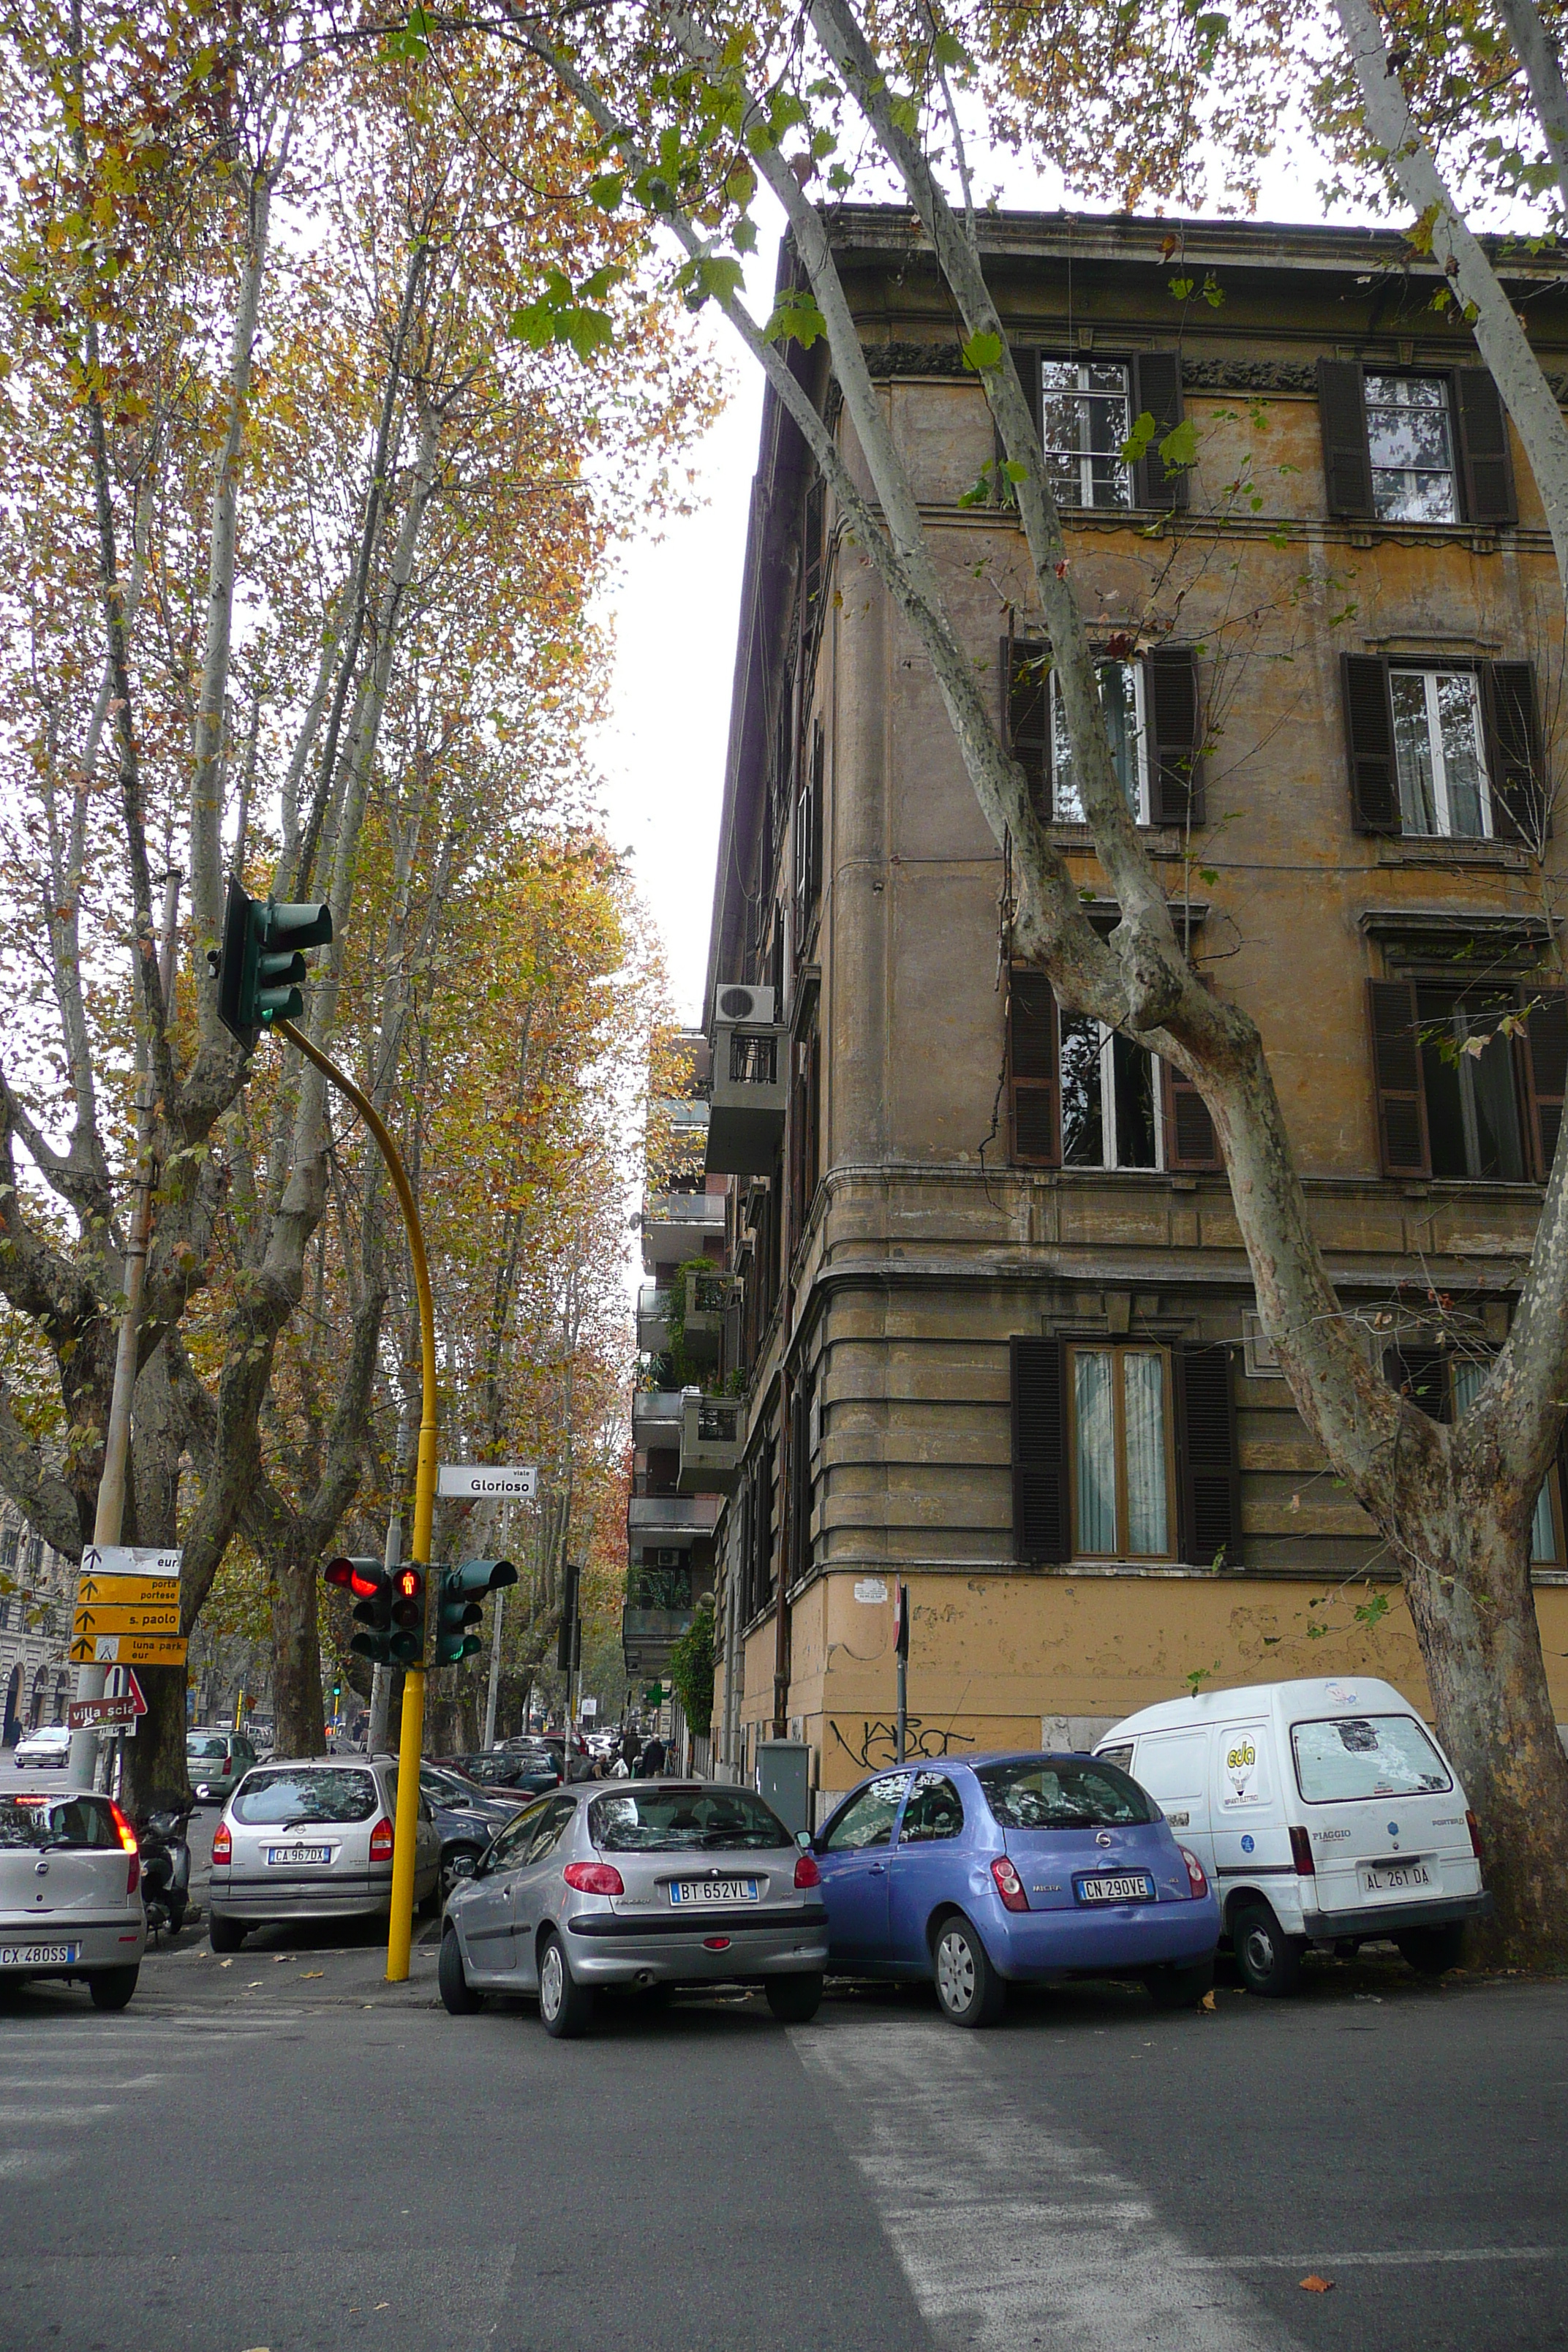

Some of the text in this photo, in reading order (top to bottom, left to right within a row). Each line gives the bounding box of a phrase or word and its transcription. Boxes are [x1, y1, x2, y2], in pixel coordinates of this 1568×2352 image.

[471, 1480, 529, 1492] Glorioso
[157, 1558, 177, 1567] eur
[152, 1580, 176, 1589] porta
[140, 1591, 176, 1600] portese
[129, 1613, 176, 1626] s. paolo
[133, 1640, 182, 1651] luna park
[73, 1706, 101, 1720] villa
[1227, 1741, 1256, 1768] eda
[1312, 1829, 1352, 1840] PIAGGIO
[276, 1850, 288, 1861] CA
[292, 1849, 323, 1861] 967DX
[1368, 1868, 1429, 1890] AL 261 DA
[681, 1884, 698, 1900] BT
[704, 1882, 748, 1899] 652VL
[1086, 1880, 1103, 1898] CN
[1108, 1877, 1147, 1896] 290VE
[2, 1947, 67, 1964] CX 480SS
